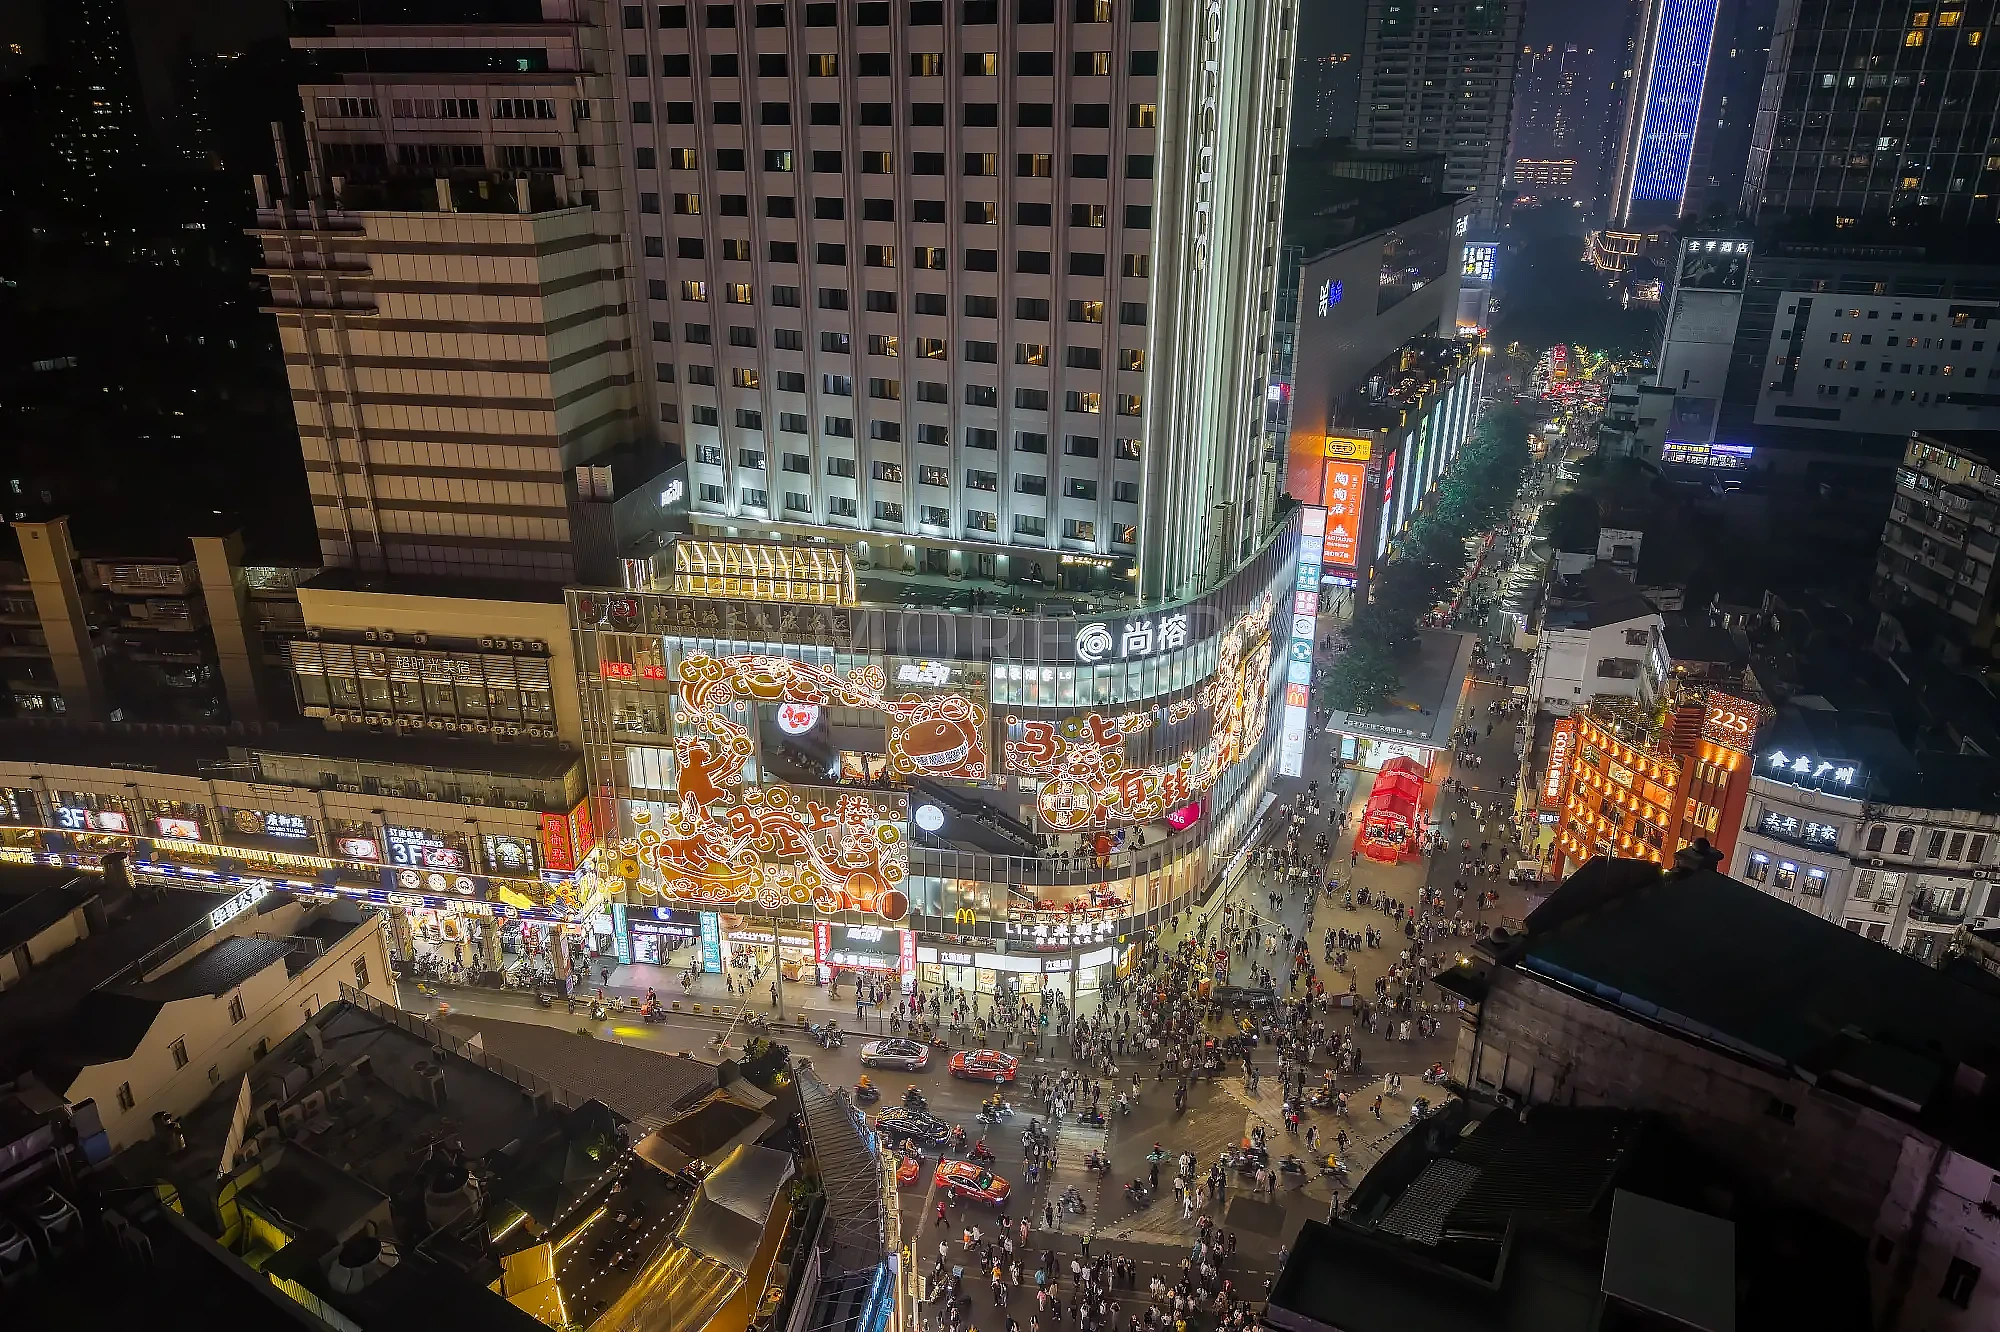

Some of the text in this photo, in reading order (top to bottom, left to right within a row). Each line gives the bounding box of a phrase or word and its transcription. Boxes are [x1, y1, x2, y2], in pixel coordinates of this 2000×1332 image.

[1689, 241, 1749, 253] 全季酒店
[1329, 471, 1349, 516] 陶陶居
[1121, 613, 1188, 658] 尚榕
[1710, 708, 1749, 733] 225
[60, 806, 84, 829] 3F
[393, 843, 422, 866] 3F
